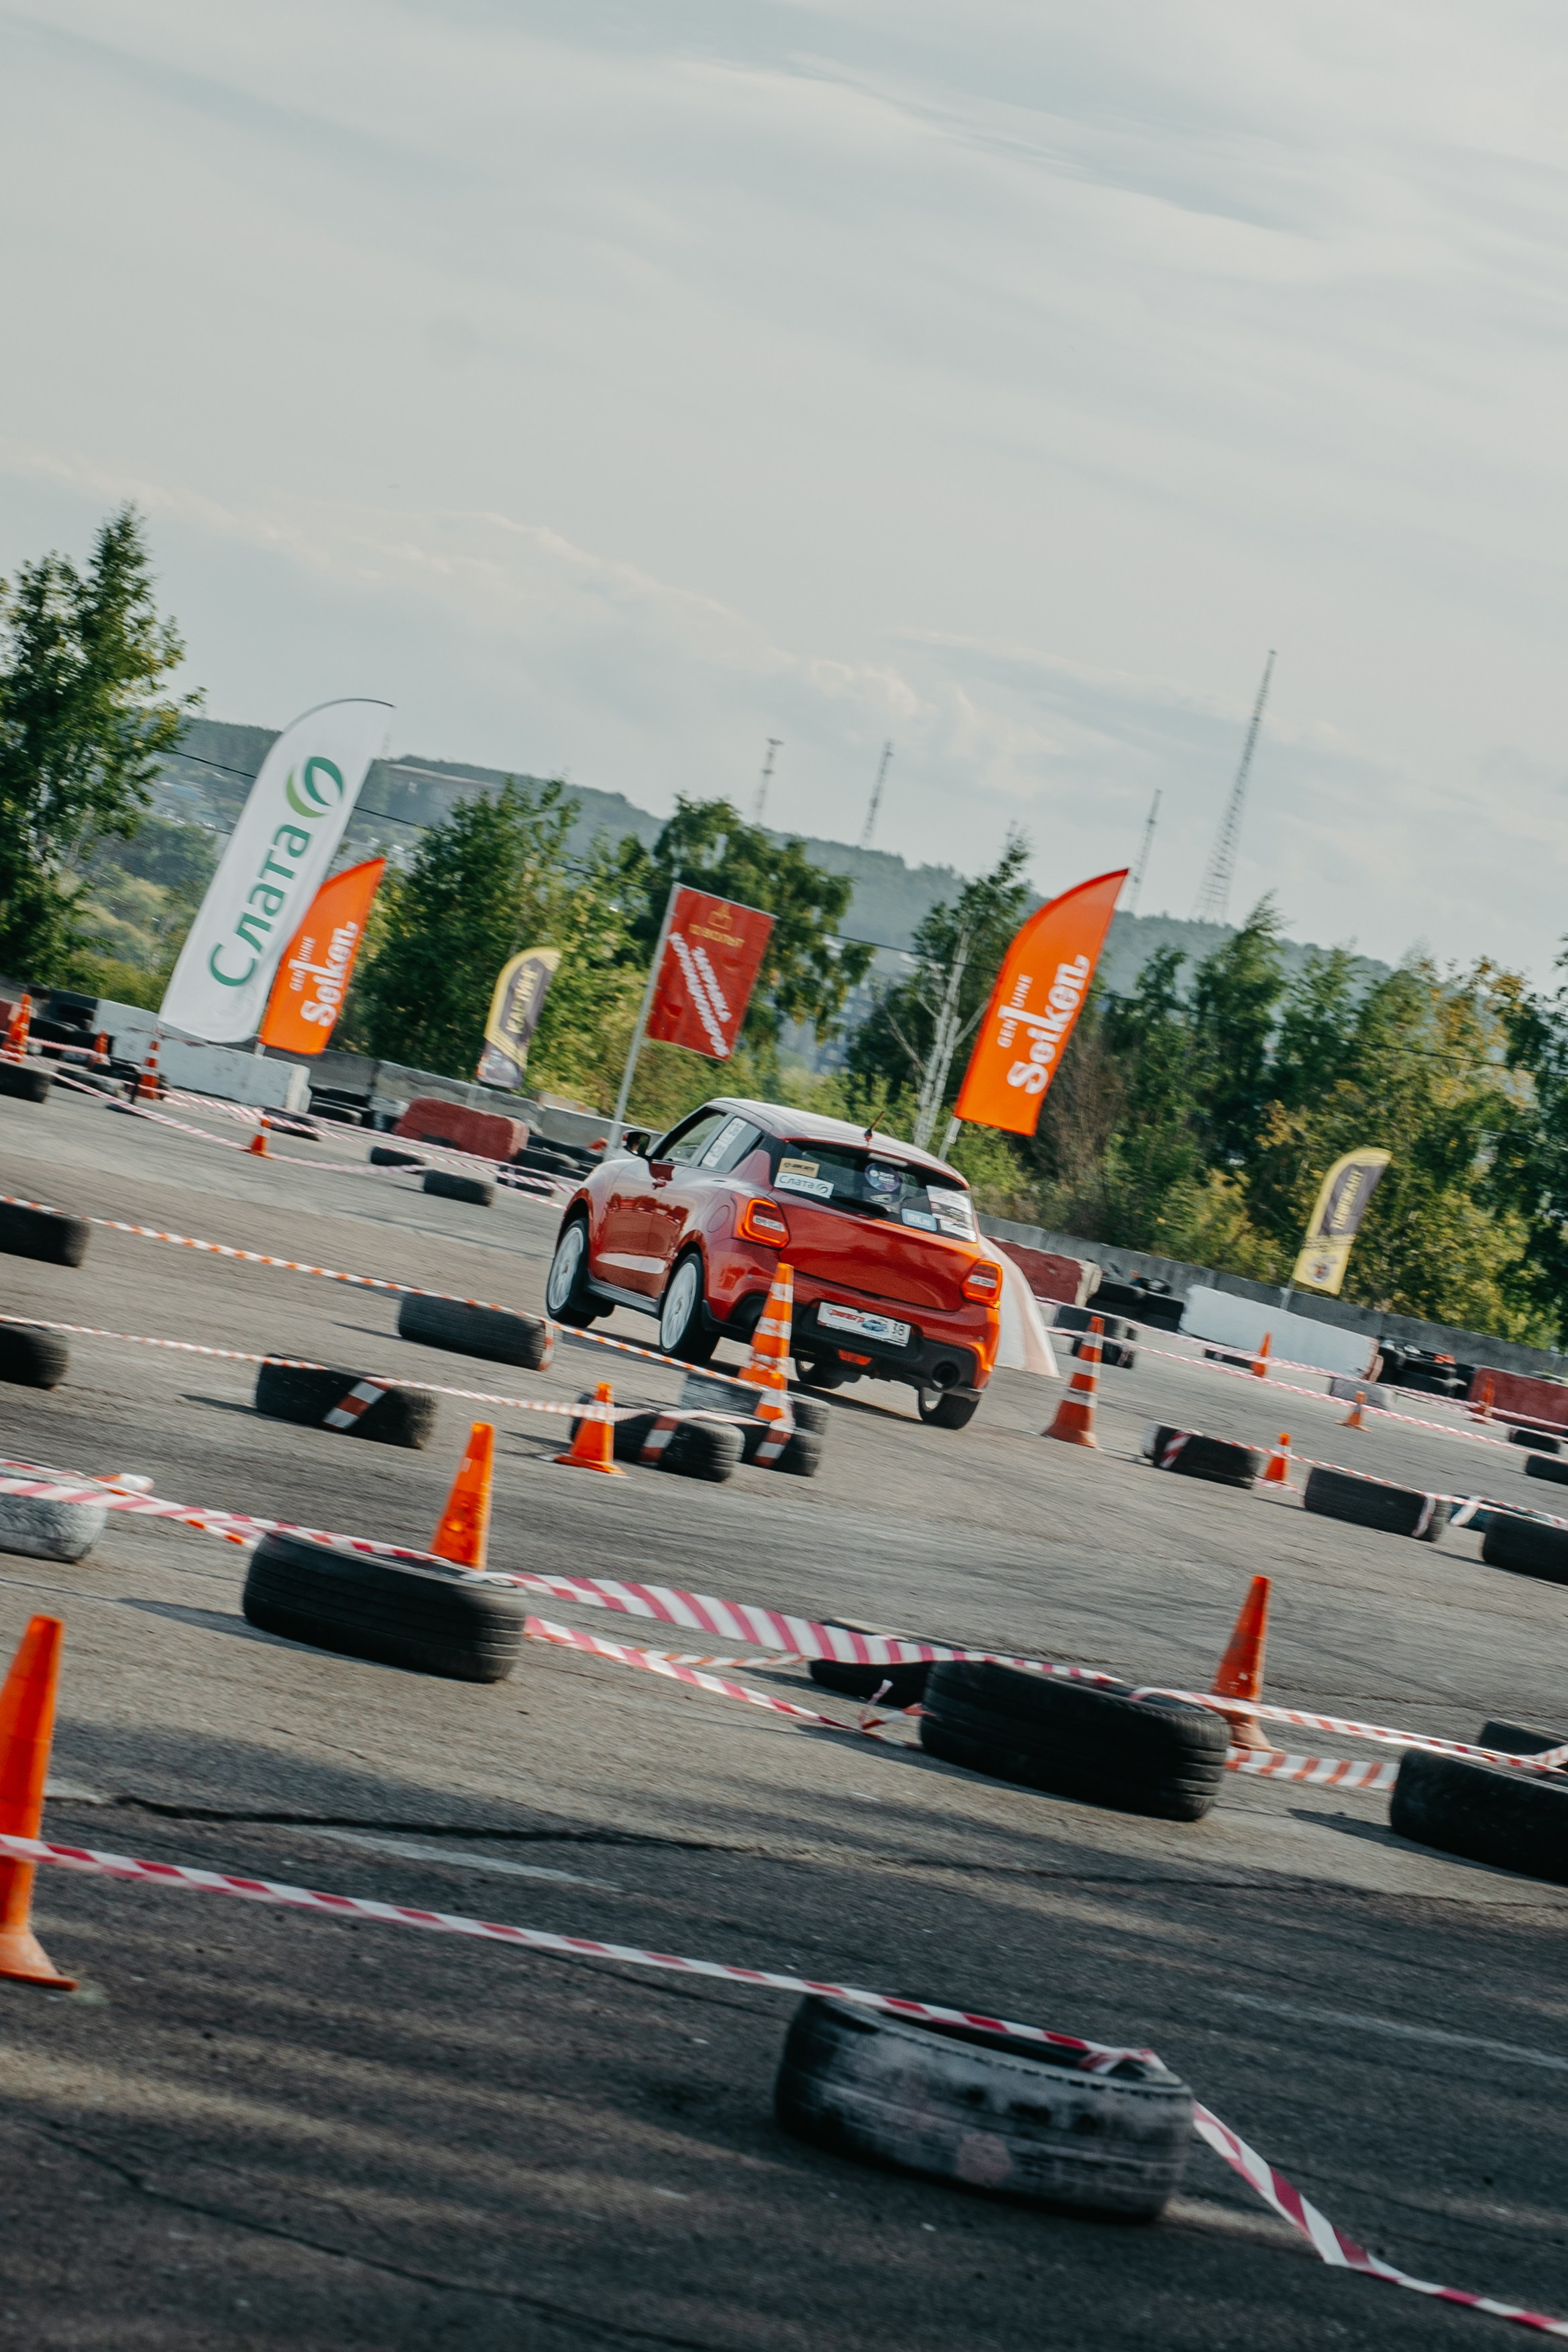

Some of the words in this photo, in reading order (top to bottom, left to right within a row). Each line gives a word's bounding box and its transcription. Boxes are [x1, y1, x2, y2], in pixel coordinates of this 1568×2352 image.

[209, 824, 311, 987] Слата
[998, 974, 1033, 1048] GENUINE
[998, 954, 1090, 1095] Seiken
[779, 1175, 814, 1189] Слата
[891, 1323, 905, 1336] 38
